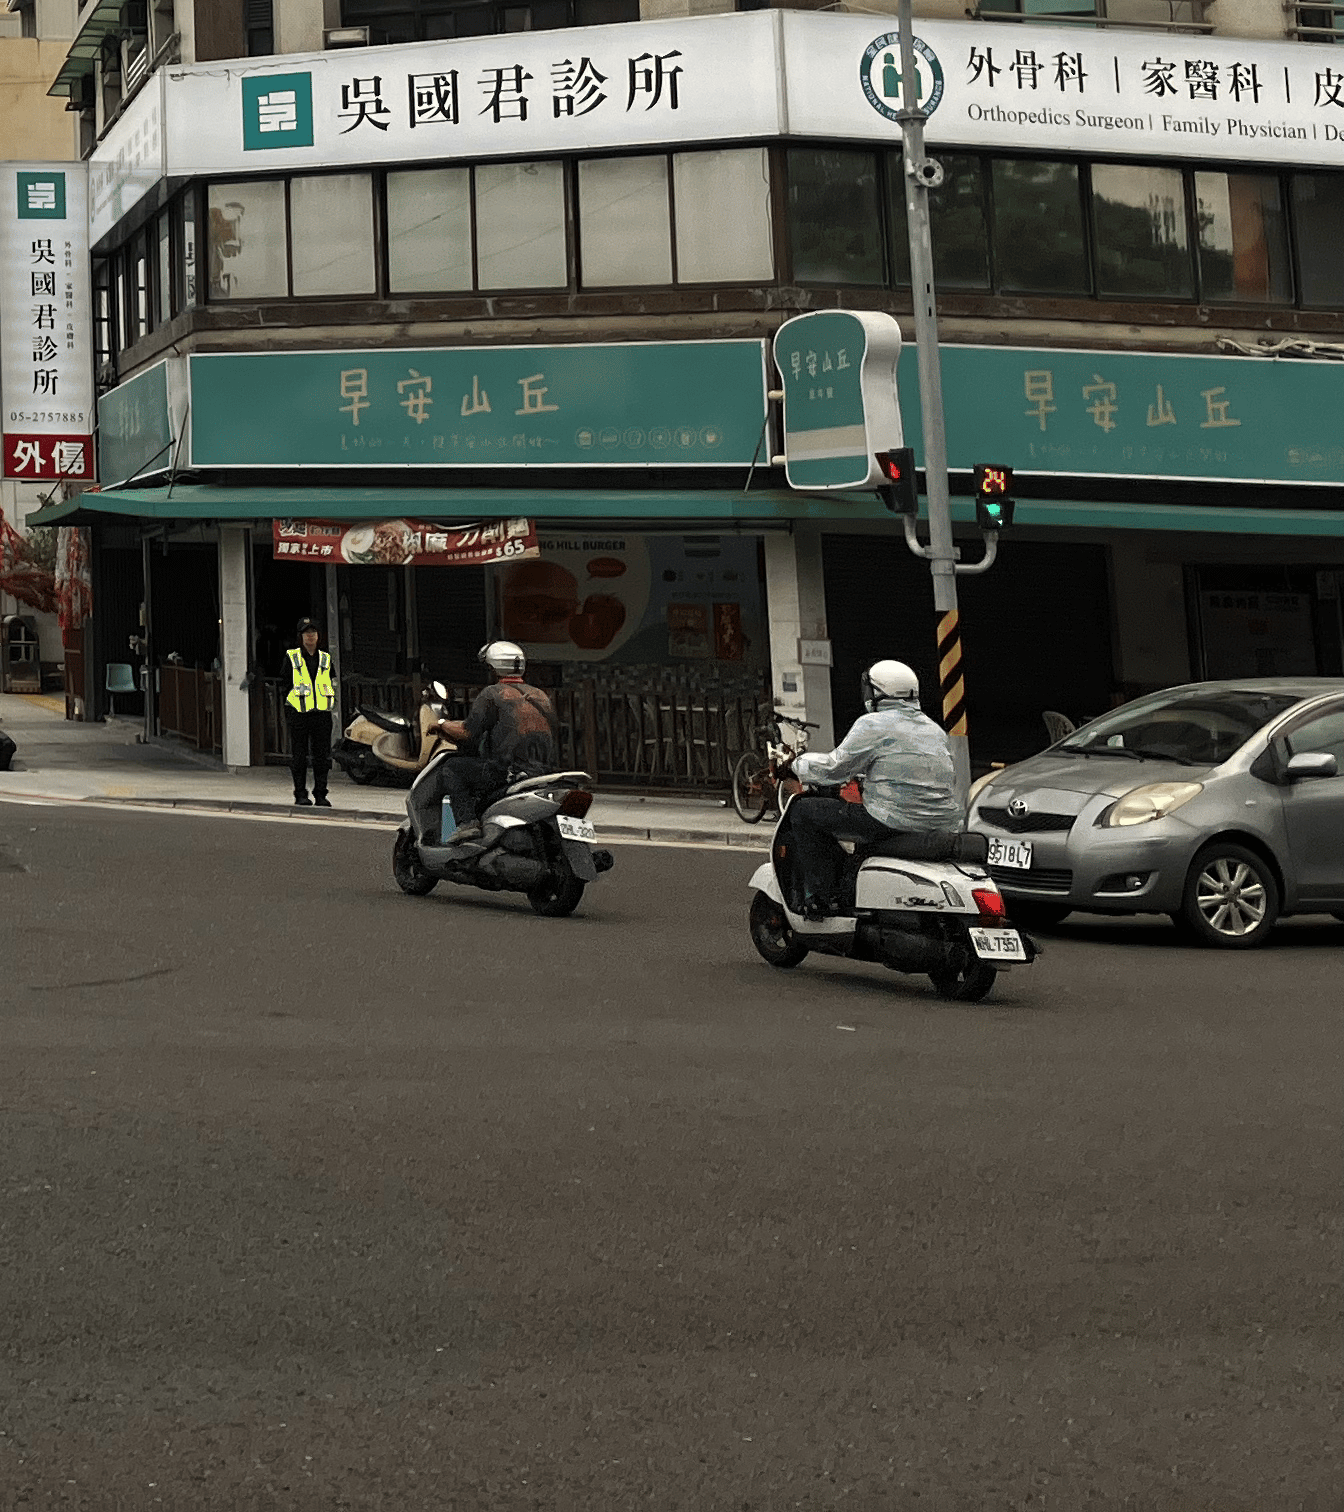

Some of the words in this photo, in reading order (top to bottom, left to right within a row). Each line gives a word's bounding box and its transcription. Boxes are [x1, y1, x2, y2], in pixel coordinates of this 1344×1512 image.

[336, 49, 685, 135] 吳國君診所
[965, 46, 1088, 93] 外骨科
[1140, 56, 1264, 105] 家醫科
[967, 103, 1071, 127] Orthopedics
[1075, 109, 1145, 131] Surgeon
[1162, 114, 1221, 136] Family
[1226, 118, 1307, 141] Physician
[30, 238, 58, 397] 吳國君診所
[790, 348, 851, 381] 早安山丘
[336, 367, 561, 428] 早安山丘
[1023, 369, 1242, 434] 早安山丘
[10, 411, 85, 424] 05-2757885
[12, 440, 86, 475] 外傷
[982, 468, 1006, 493] 24
[495, 538, 526, 557] $65
[556, 540, 581, 551] HILL
[582, 540, 627, 552] BURGER
